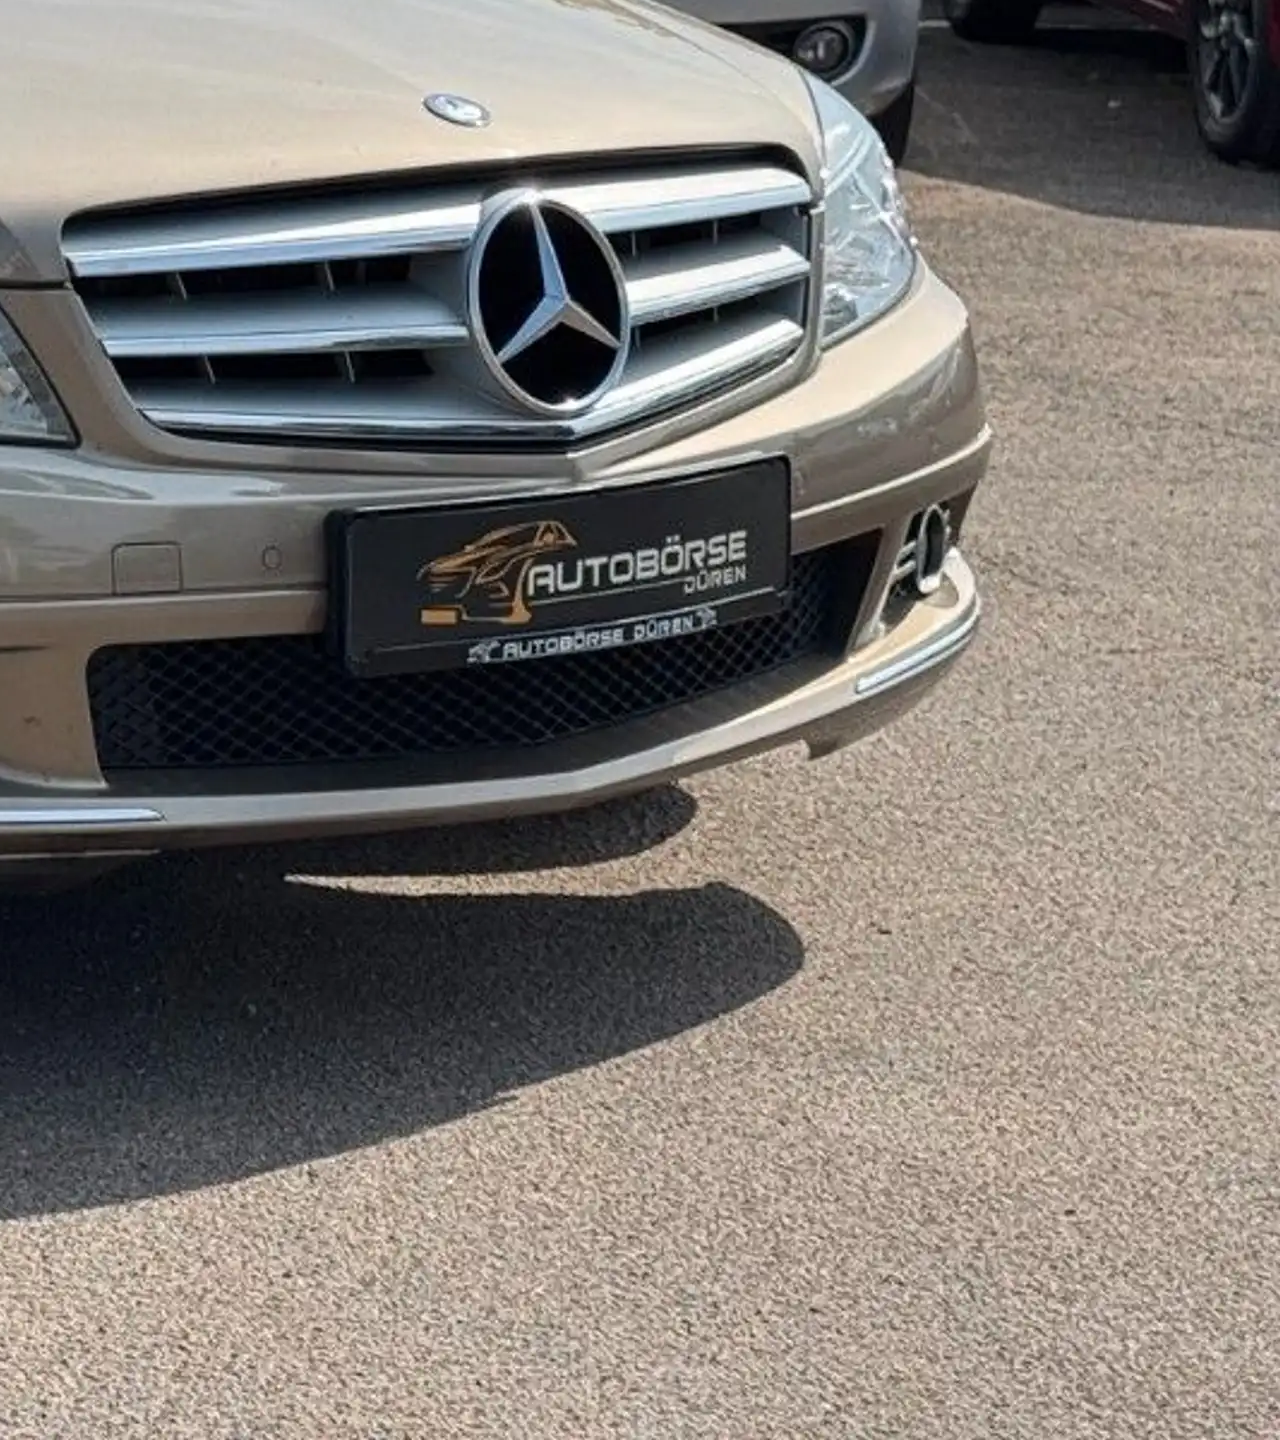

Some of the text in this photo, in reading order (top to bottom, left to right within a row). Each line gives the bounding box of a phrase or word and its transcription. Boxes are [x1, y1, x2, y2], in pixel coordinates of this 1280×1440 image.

[527, 529, 748, 597] AUTOBÖRSE
[683, 563, 747, 594] DÜREN
[502, 612, 695, 661] AUTOBÖRSE DÜREN
